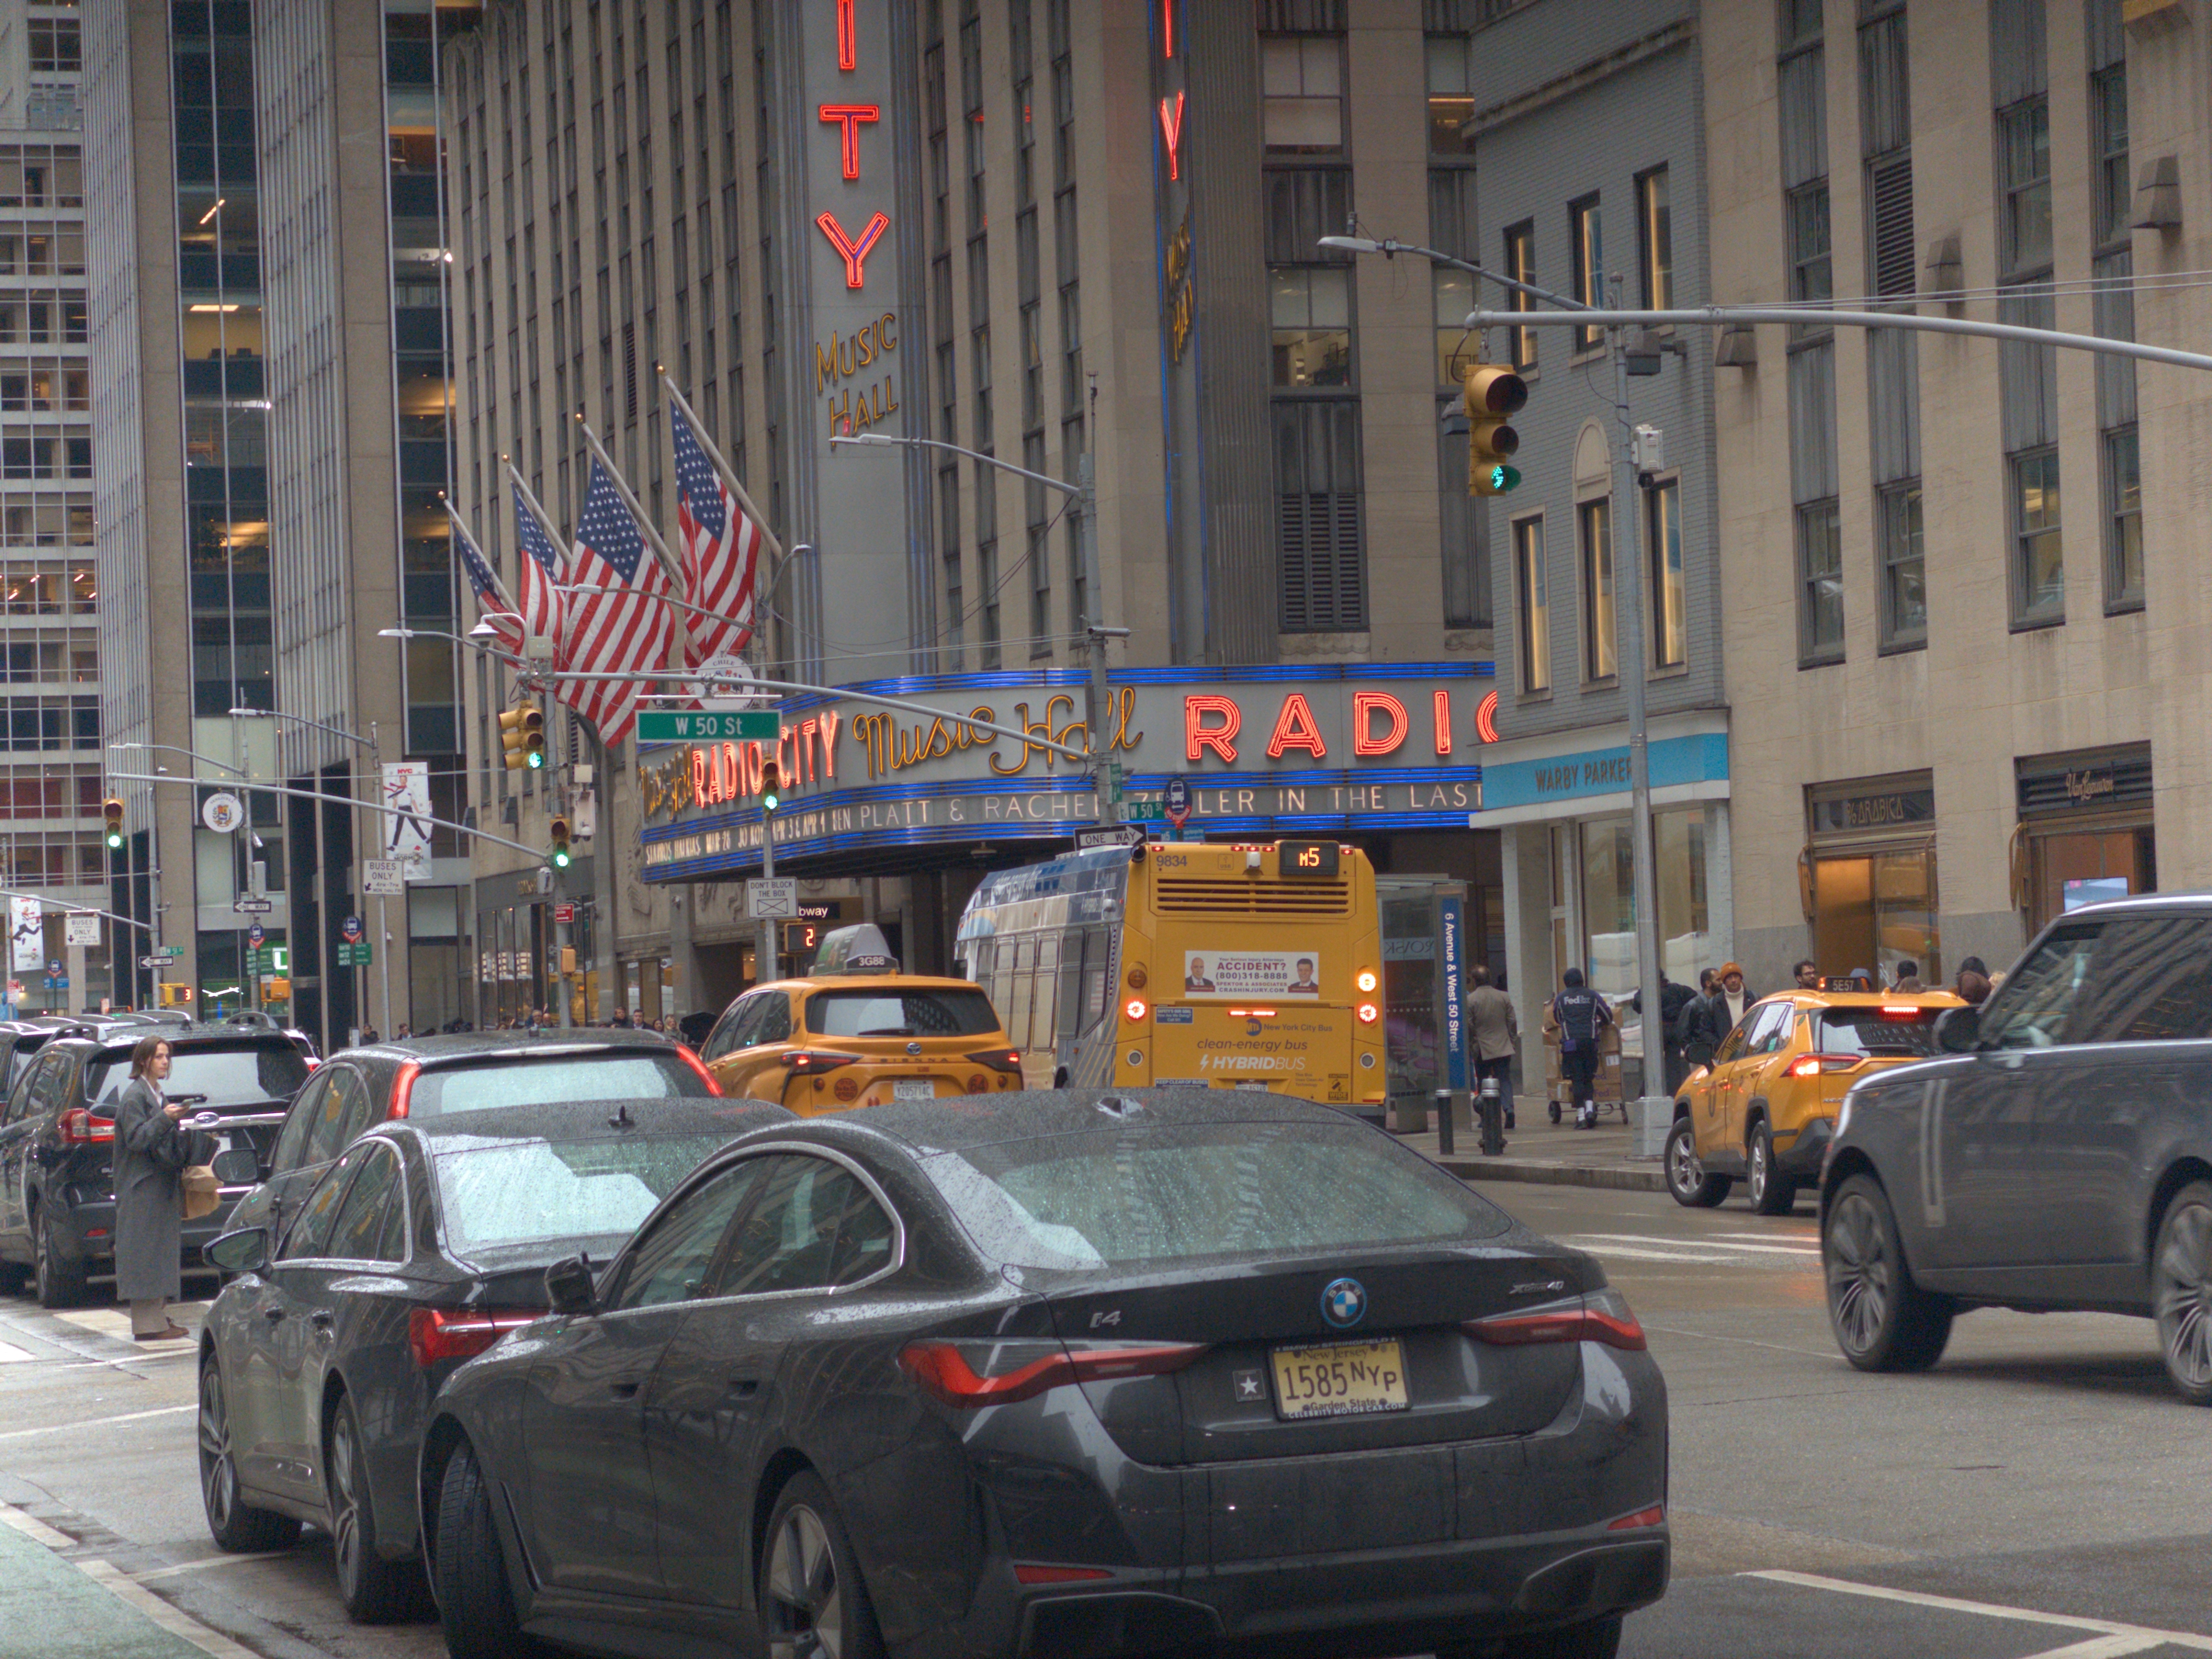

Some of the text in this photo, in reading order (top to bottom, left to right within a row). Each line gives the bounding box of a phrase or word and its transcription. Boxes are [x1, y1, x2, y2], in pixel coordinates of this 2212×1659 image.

[816, 313, 897, 394] MUSIC
[829, 375, 899, 448] HALL
[675, 717, 742, 736] W 50 St
[692, 742, 763, 809] RADIO
[777, 710, 838, 788] CITY
[853, 706, 997, 779] Music
[1535, 764, 1578, 792] WARBY
[1129, 802, 1162, 818] W 50 St
[1847, 797, 1904, 825] % ARABICA
[738, 827, 748, 848] JO
[750, 824, 764, 846] KOY
[789, 817, 793, 839] 3
[803, 814, 817, 836] APR
[832, 808, 851, 831] BEN
[861, 799, 931, 829] PLATT
[950, 799, 964, 822] &
[1279, 788, 1305, 811] IN
[1330, 786, 1384, 809] THE
[1086, 831, 1136, 844] ONE WAY
[1161, 832, 1170, 841] M5
[1156, 855, 1187, 867] 9834
[1299, 848, 1319, 866] M5
[370, 862, 396, 870] BUSES
[806, 928, 814, 947] 2
[1445, 923, 1454, 962] Avenue
[858, 956, 885, 967] 3G88
[1217, 962, 1286, 970] ACCIDENT?
[1216, 972, 1288, 980] (800)318-8888
[1447, 974, 1457, 1001] West
[1832, 979, 1854, 991] 5E57
[185, 989, 190, 1001] 3
[1564, 995, 1590, 1005] FedEx
[1448, 1005, 1458, 1018] 50
[1301, 1024, 1316, 1032] City
[1449, 1020, 1459, 1052] Street
[1197, 1039, 1308, 1052] clean-energy bus
[896, 1086, 930, 1097] Y205714C
[1089, 1311, 1121, 1328] i4
[1321, 1338, 1389, 1349] SPRINGFIELD
[1303, 1347, 1368, 1361] New Jersey
[1311, 1398, 1377, 1412] Garden State
[1289, 1408, 1332, 1419] CELEBRITY
[1334, 1406, 1364, 1415] MOTOR
